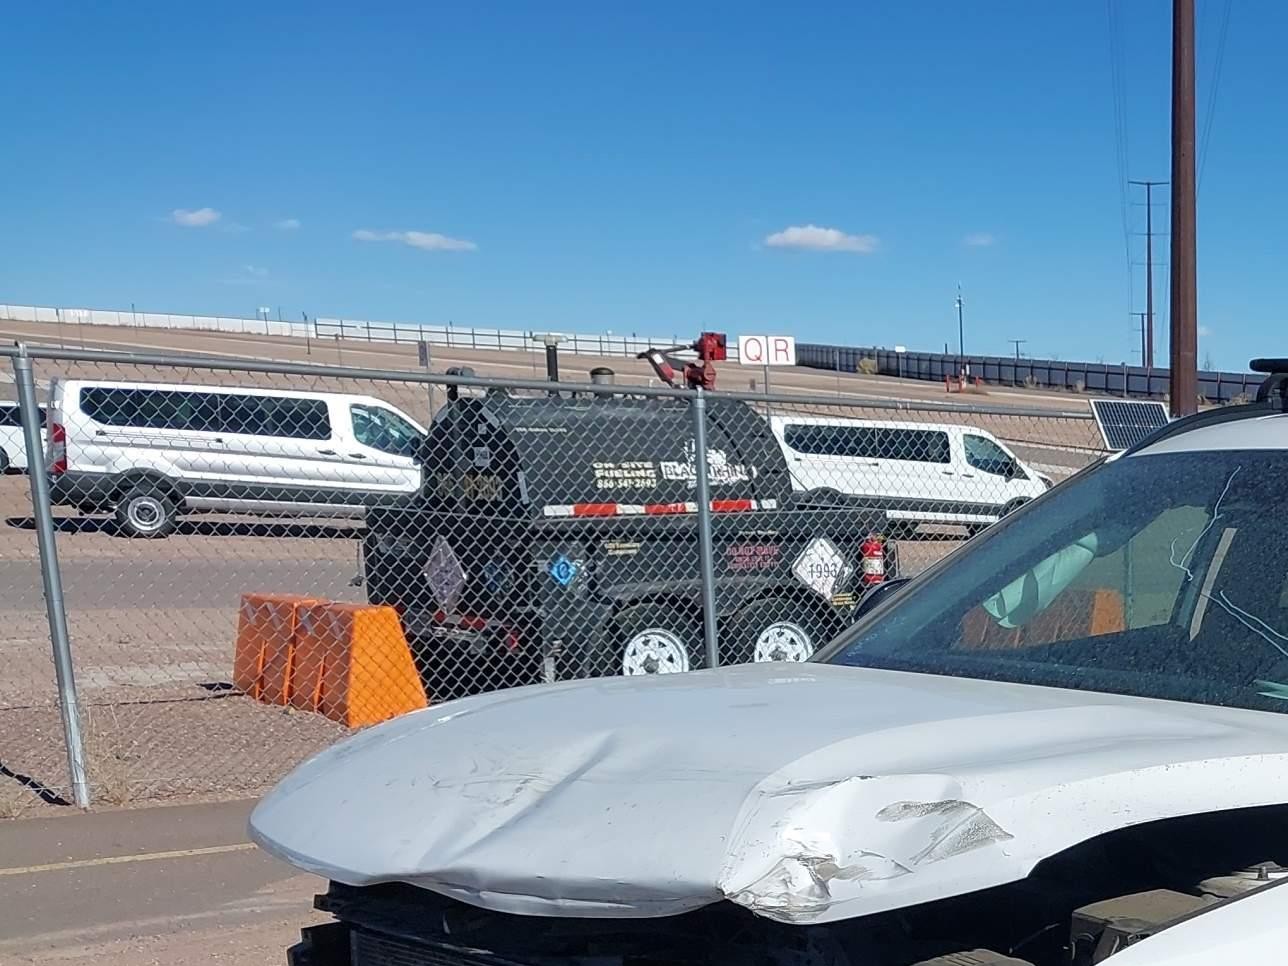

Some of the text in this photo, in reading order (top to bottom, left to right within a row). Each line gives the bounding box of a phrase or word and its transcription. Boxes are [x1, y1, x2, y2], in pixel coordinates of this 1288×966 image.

[745, 338, 789, 362] Q R
[809, 563, 837, 578] 1993
